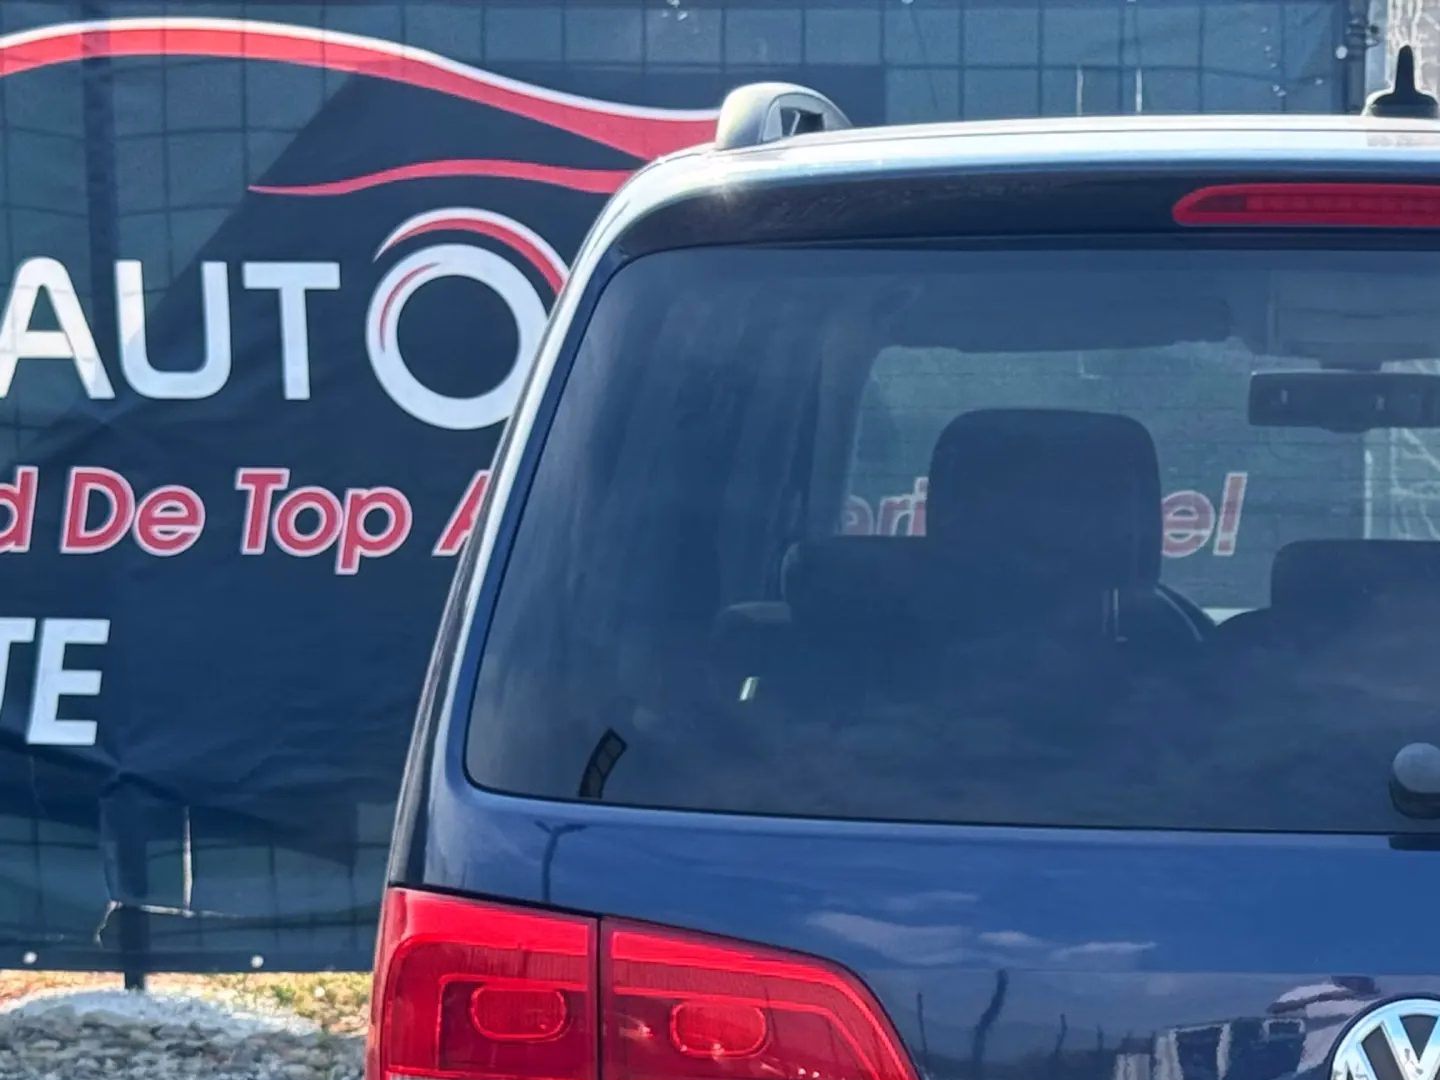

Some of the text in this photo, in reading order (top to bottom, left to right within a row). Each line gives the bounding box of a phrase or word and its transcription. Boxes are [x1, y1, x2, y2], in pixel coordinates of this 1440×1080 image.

[0, 244, 548, 430] AUTO
[60, 466, 206, 557] De
[235, 467, 413, 575] Top
